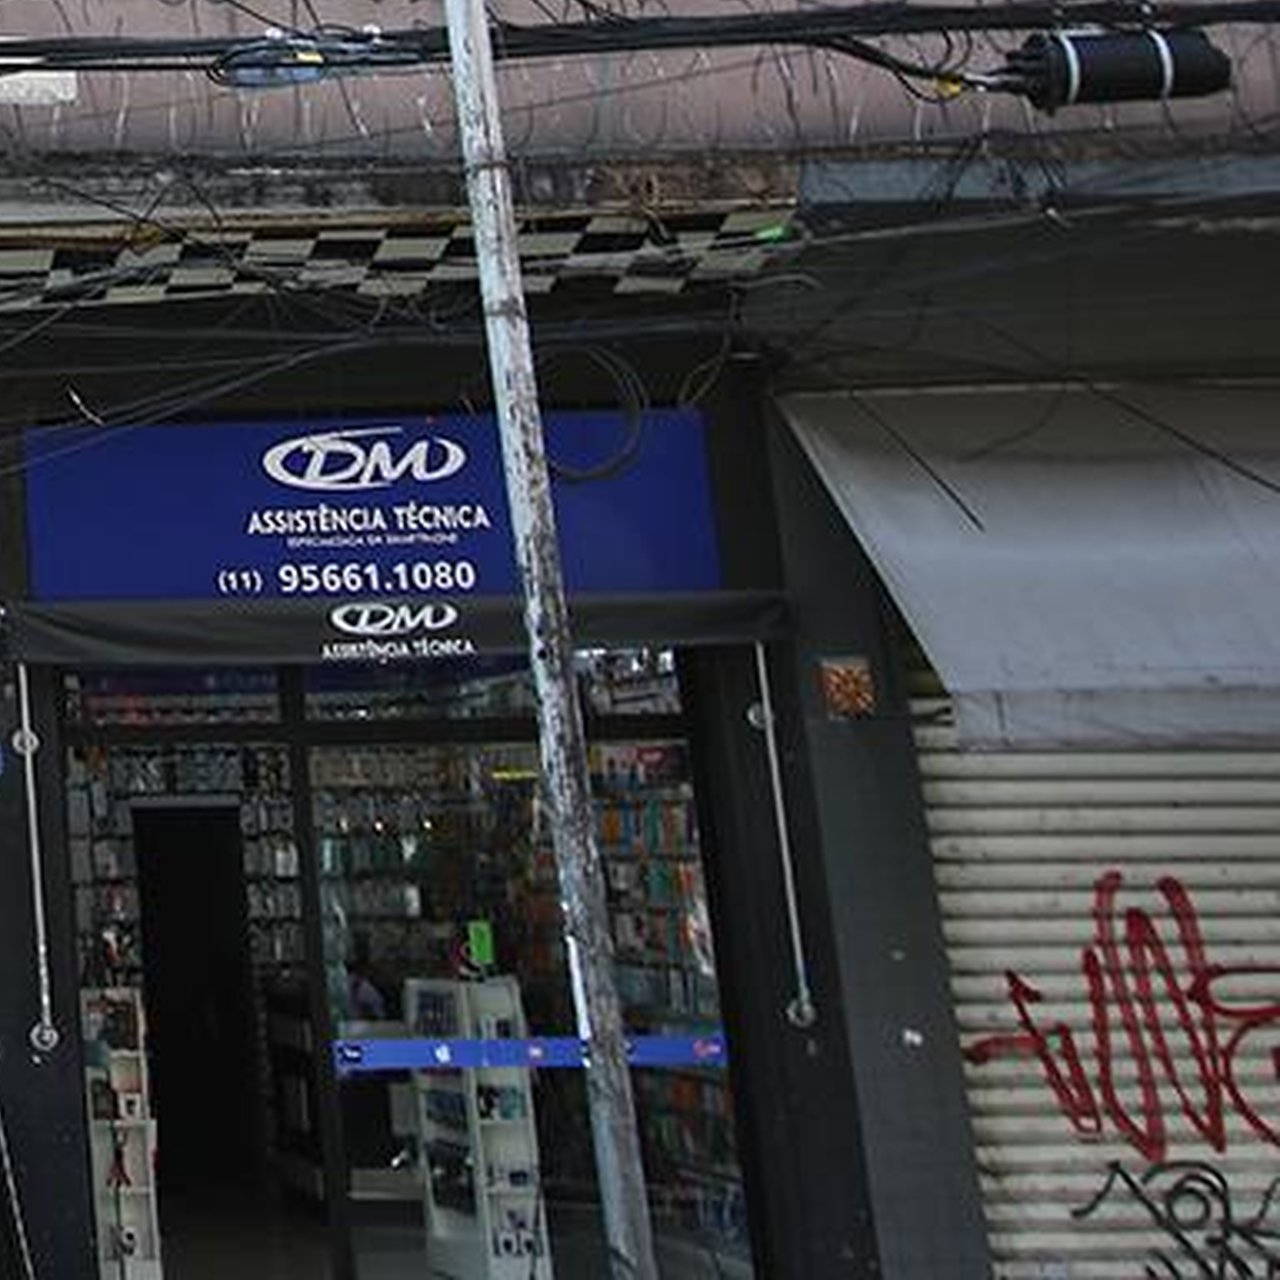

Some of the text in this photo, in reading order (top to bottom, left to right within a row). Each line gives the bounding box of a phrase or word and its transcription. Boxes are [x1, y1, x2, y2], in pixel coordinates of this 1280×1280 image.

[247, 499, 491, 535] ASSISTÊNCIA TÉCNICA
[217, 561, 477, 593] (11) 95661.1080
